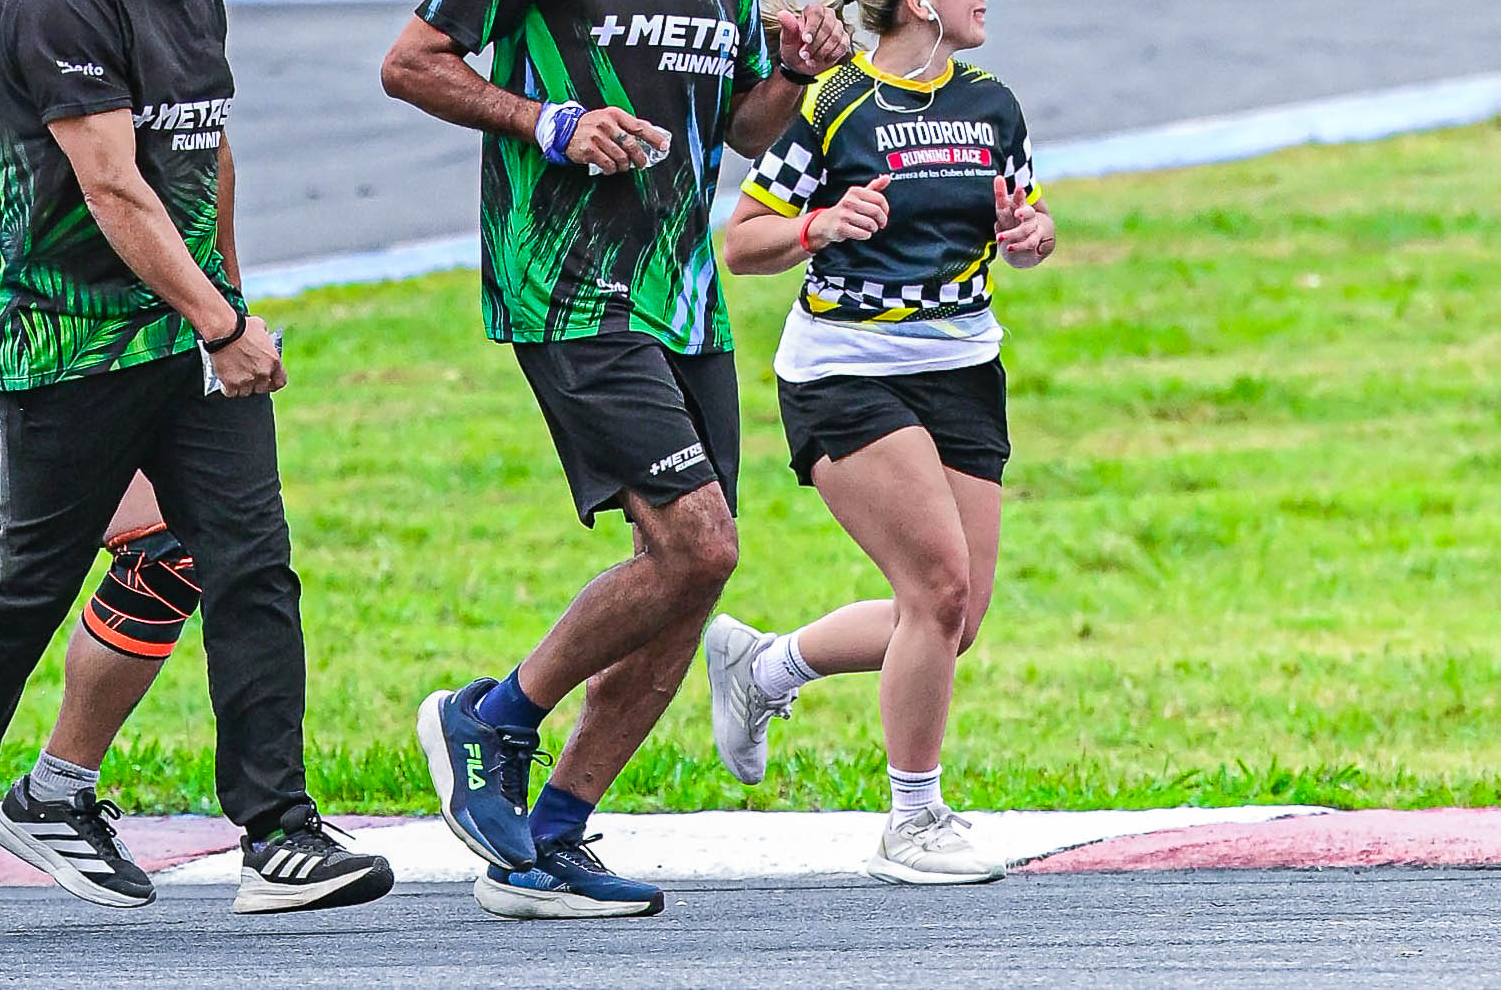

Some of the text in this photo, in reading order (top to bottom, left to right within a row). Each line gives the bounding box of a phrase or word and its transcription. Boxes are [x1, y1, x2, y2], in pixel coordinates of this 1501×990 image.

[875, 115, 995, 151] AUTÓDROMO
[900, 147, 982, 167] RUNNING RACE
[890, 171, 918, 181] Carrera
[463, 743, 486, 790] FILA
